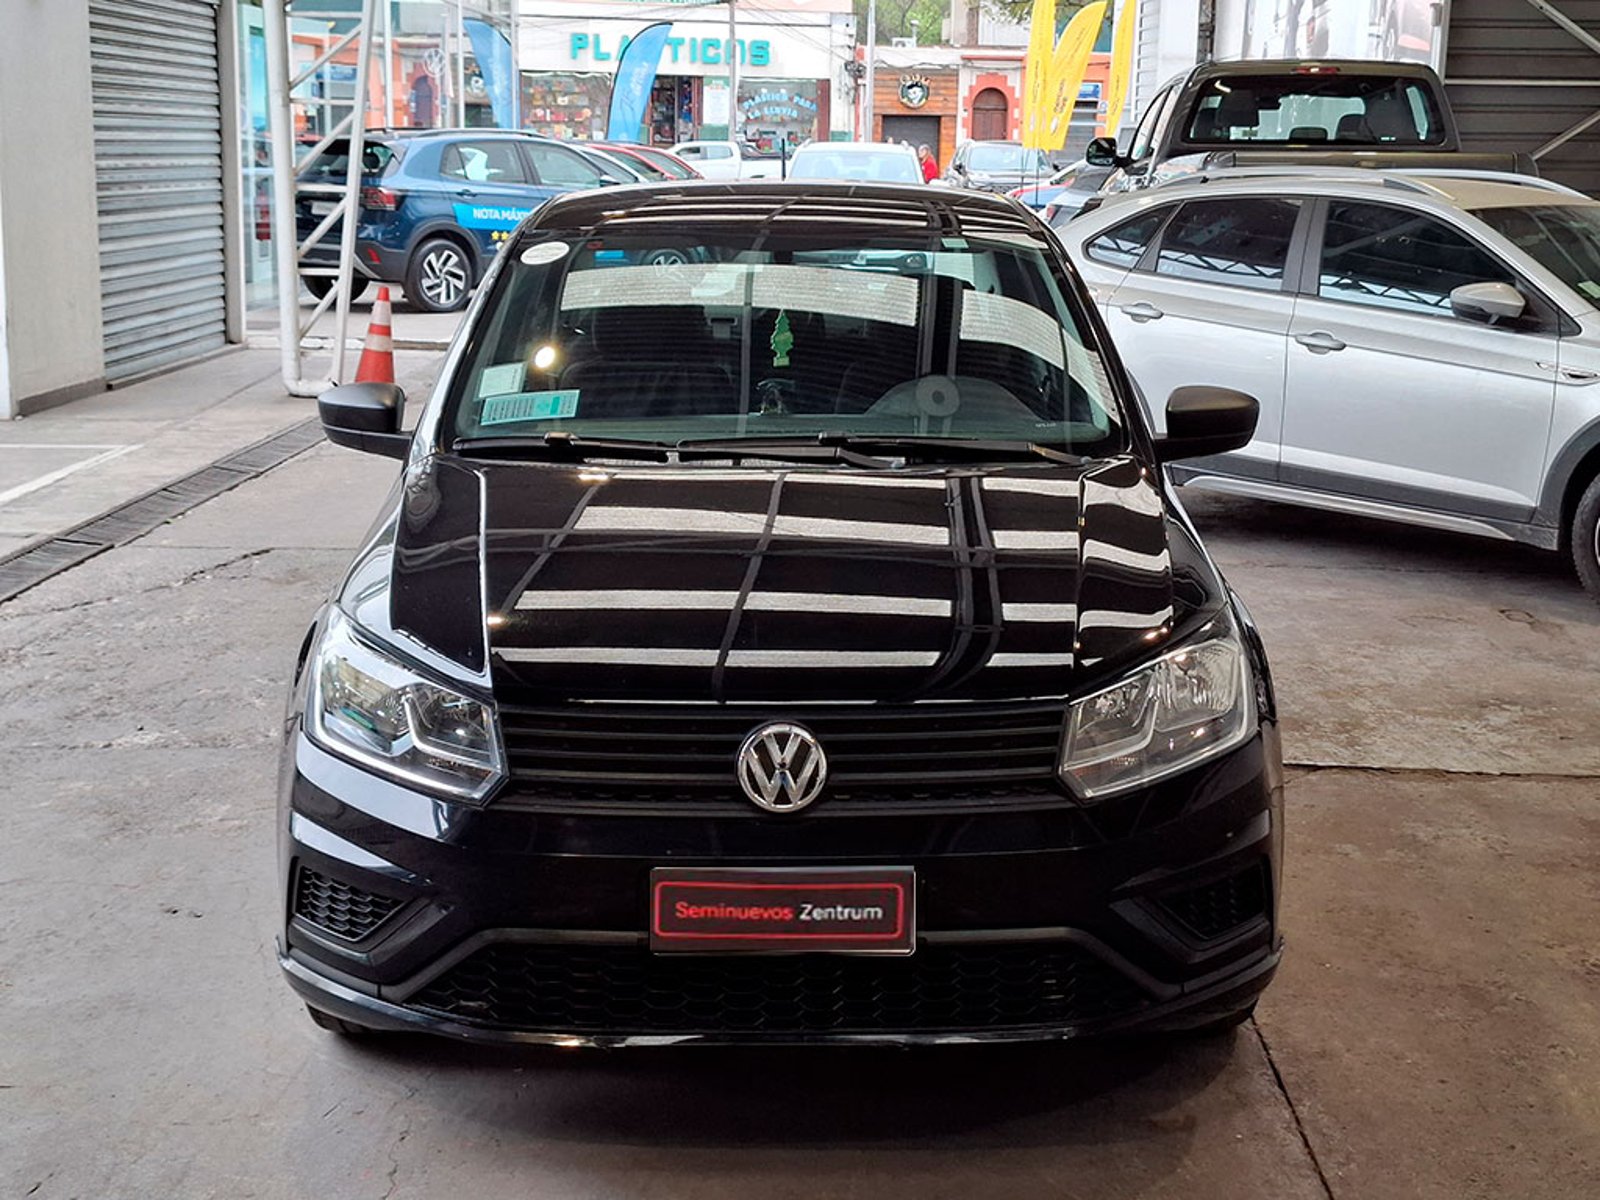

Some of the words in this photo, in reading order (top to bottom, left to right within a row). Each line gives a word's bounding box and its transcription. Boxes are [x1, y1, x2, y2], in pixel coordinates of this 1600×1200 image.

[570, 32, 770, 66] PLTICOS
[473, 208, 500, 219] NOTA
[675, 902, 794, 919] Seminuevos
[800, 904, 883, 921] Zentrum
